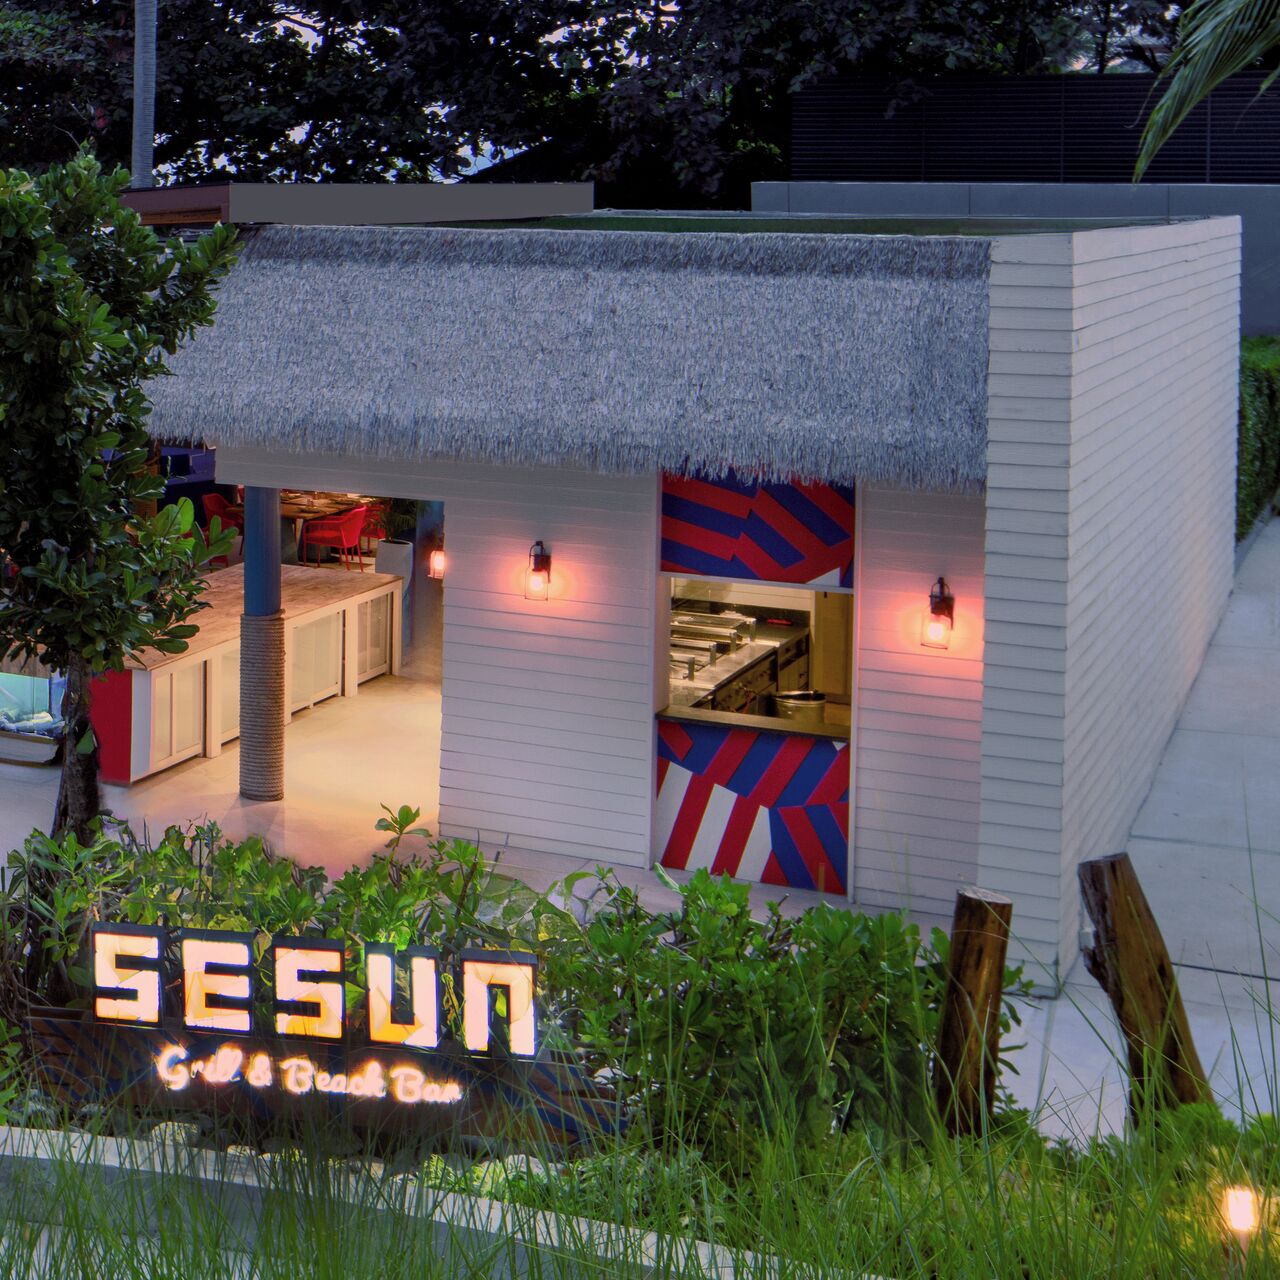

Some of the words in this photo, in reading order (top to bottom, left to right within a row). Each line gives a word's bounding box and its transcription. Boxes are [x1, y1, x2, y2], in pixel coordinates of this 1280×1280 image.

[156, 1045, 243, 1091] Grill
[247, 1052, 273, 1087] &
[279, 1057, 387, 1098] Beach
[389, 1066, 463, 1104] Bar
